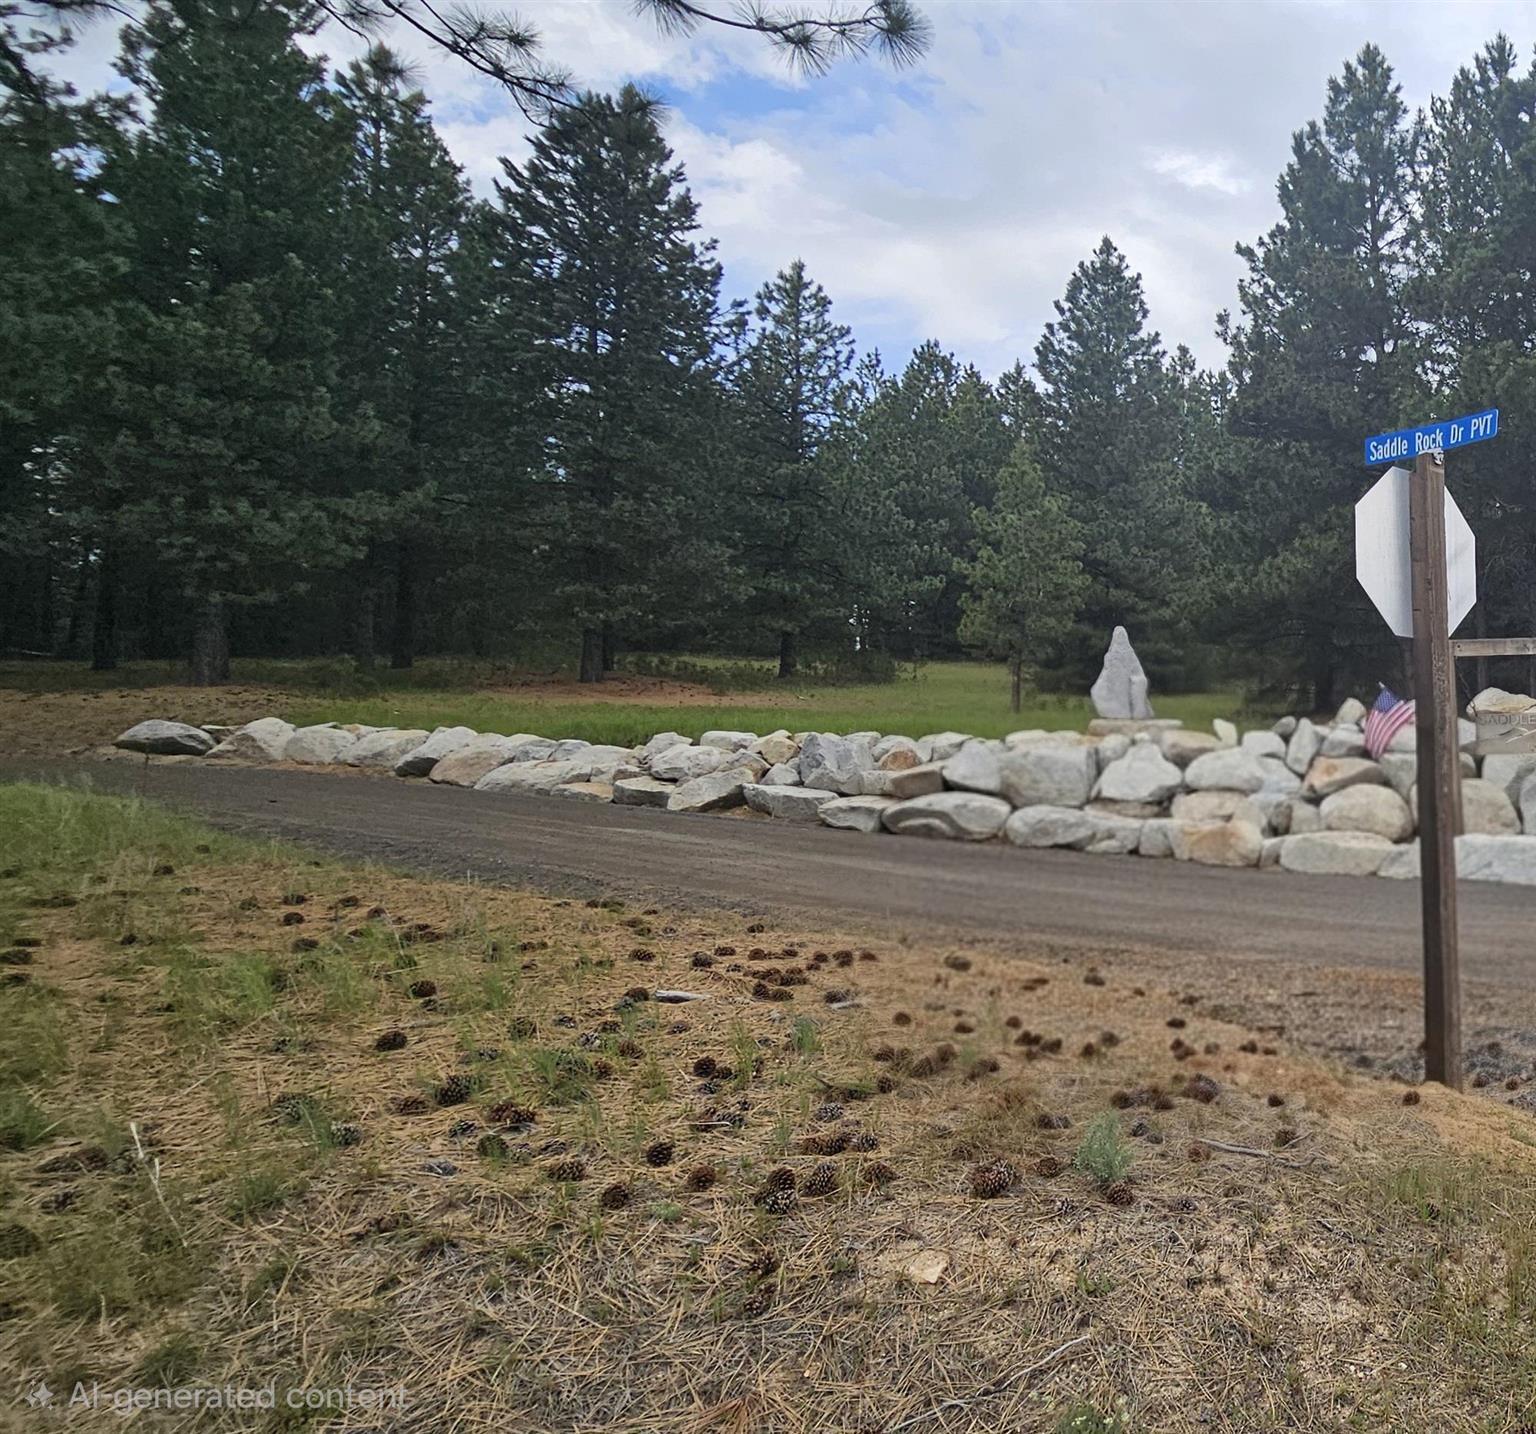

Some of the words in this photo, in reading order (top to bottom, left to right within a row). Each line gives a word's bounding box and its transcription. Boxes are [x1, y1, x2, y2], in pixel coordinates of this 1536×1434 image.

[1370, 436, 1408, 461] Saddle
[1415, 429, 1443, 452] Rock
[1450, 424, 1464, 444] Dr
[1470, 414, 1493, 438] PVT
